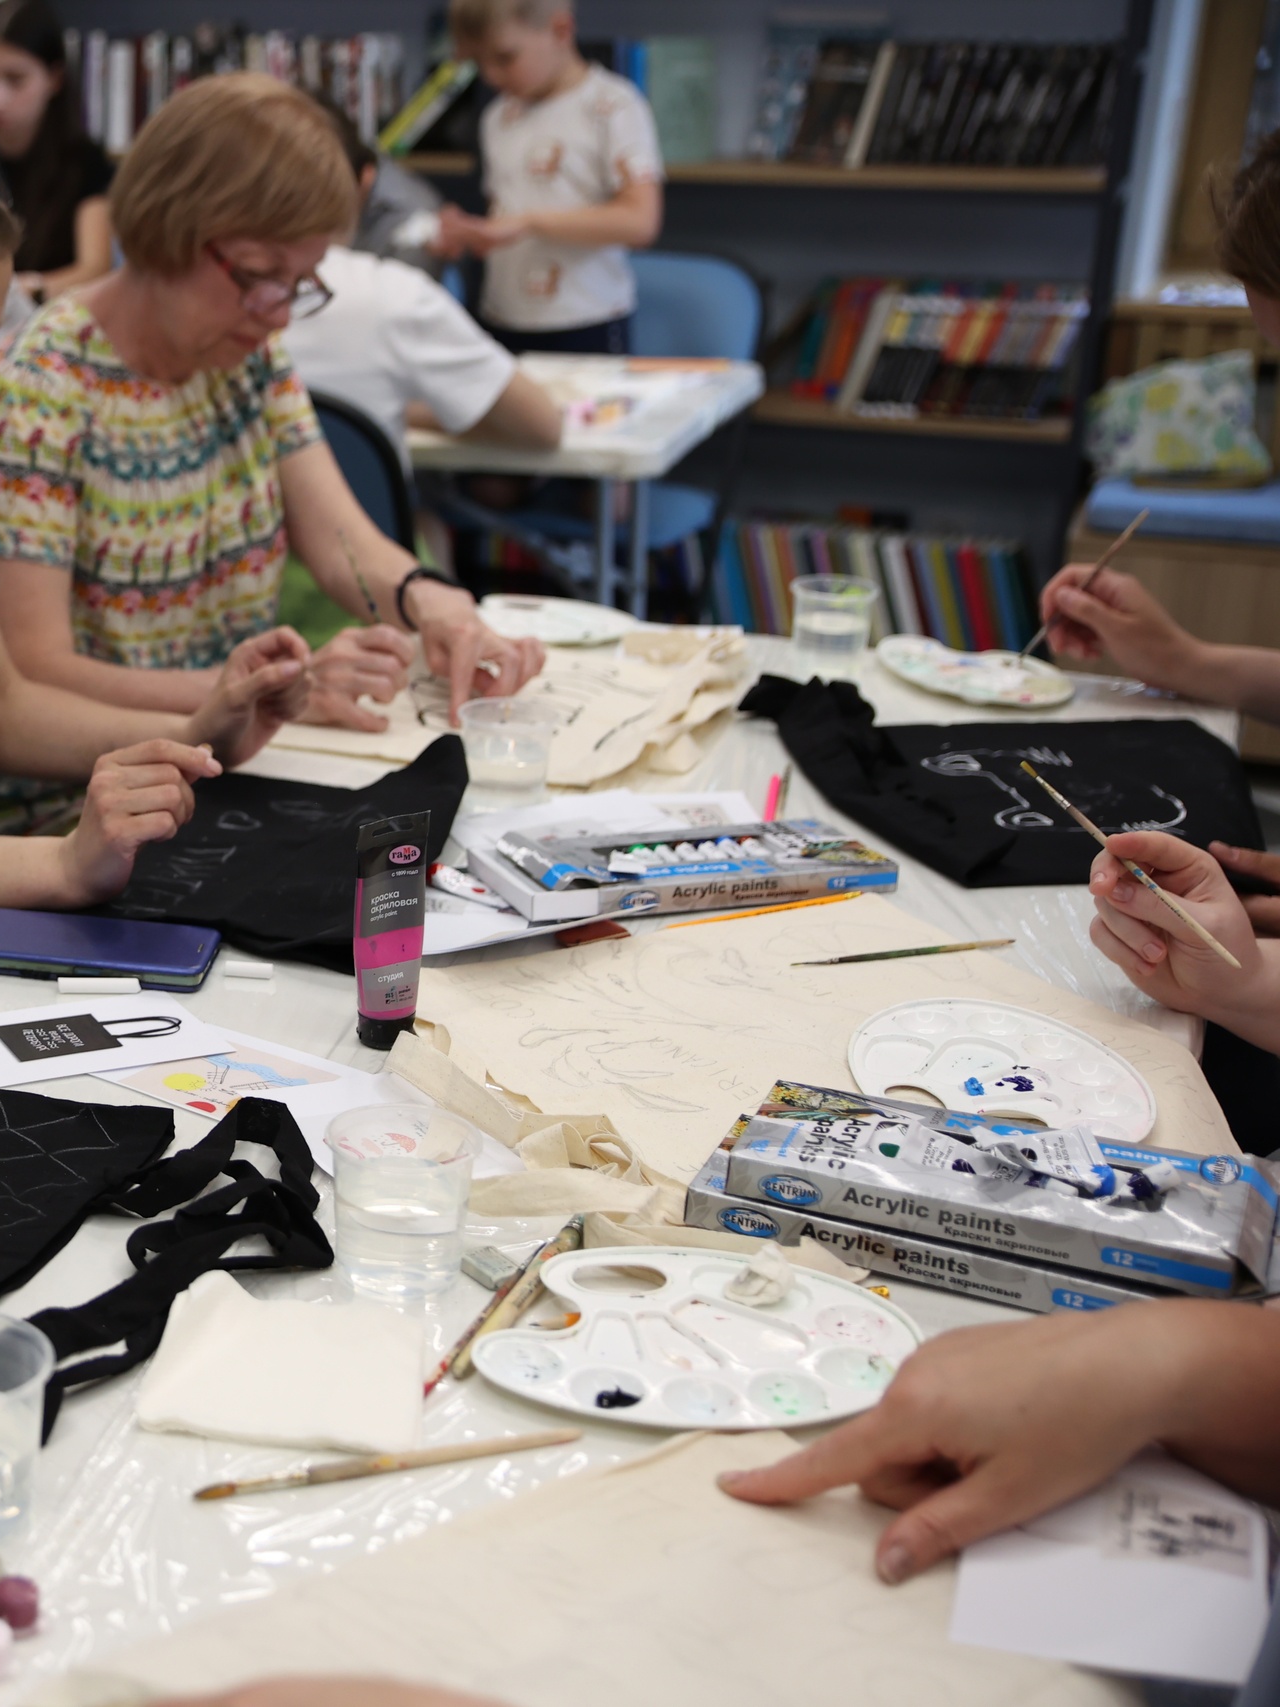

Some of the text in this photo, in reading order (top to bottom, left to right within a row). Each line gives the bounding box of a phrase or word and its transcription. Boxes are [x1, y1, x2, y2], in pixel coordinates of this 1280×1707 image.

[371, 891, 400, 906] краска
[672, 878, 778, 899] Acrylic paints
[370, 898, 418, 914] акриловая
[377, 971, 404, 983] студия
[798, 1119, 831, 1164] paints
[828, 1118, 870, 1171] Acrylic
[763, 1179, 819, 1200] CENTRUM
[723, 1212, 776, 1232] CENTRUM
[842, 1187, 1017, 1237] Acrylic paints
[799, 1221, 970, 1276] Acrylic paints
[944, 1226, 1070, 1260] Краски акриловые
[1111, 1250, 1134, 1266] 12
[898, 1263, 1023, 1299] Краски акриловые
[1062, 1293, 1084, 1308] 12
